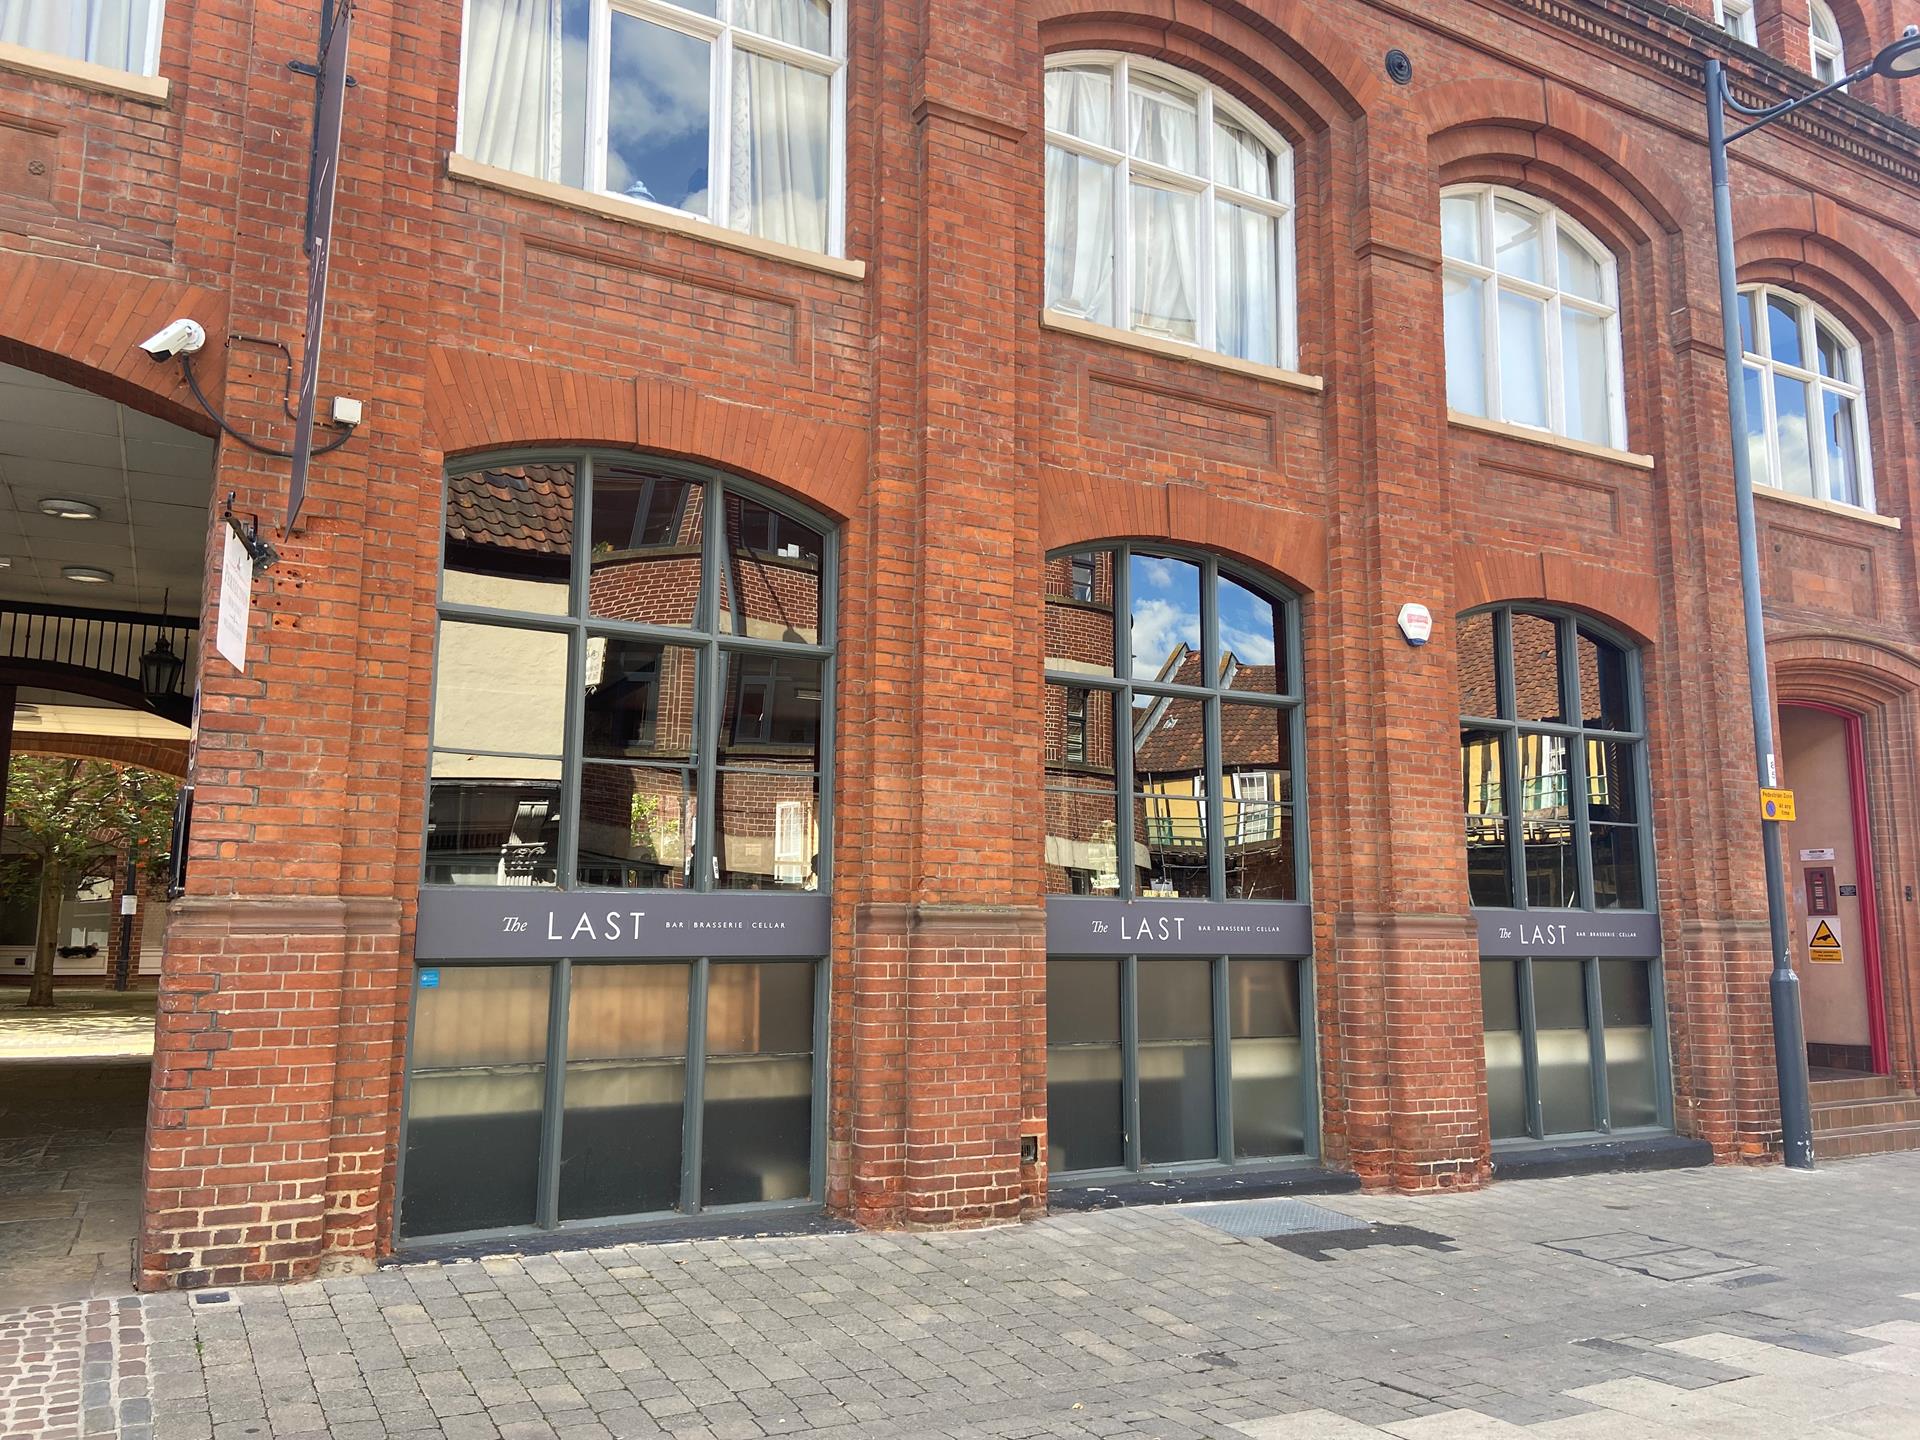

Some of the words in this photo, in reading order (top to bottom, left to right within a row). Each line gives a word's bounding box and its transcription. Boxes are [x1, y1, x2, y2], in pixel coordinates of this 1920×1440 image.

[502, 916, 528, 933] The
[547, 911, 646, 941] LAST
[665, 921, 684, 929] BAR
[693, 921, 743, 930] BRASSERIE
[751, 921, 786, 930] CELLAR
[1091, 920, 1109, 936] The
[1121, 916, 1185, 941] LAST
[1216, 925, 1251, 933] BRASSERIE
[1499, 928, 1512, 938] The
[1520, 924, 1567, 944] LAST
